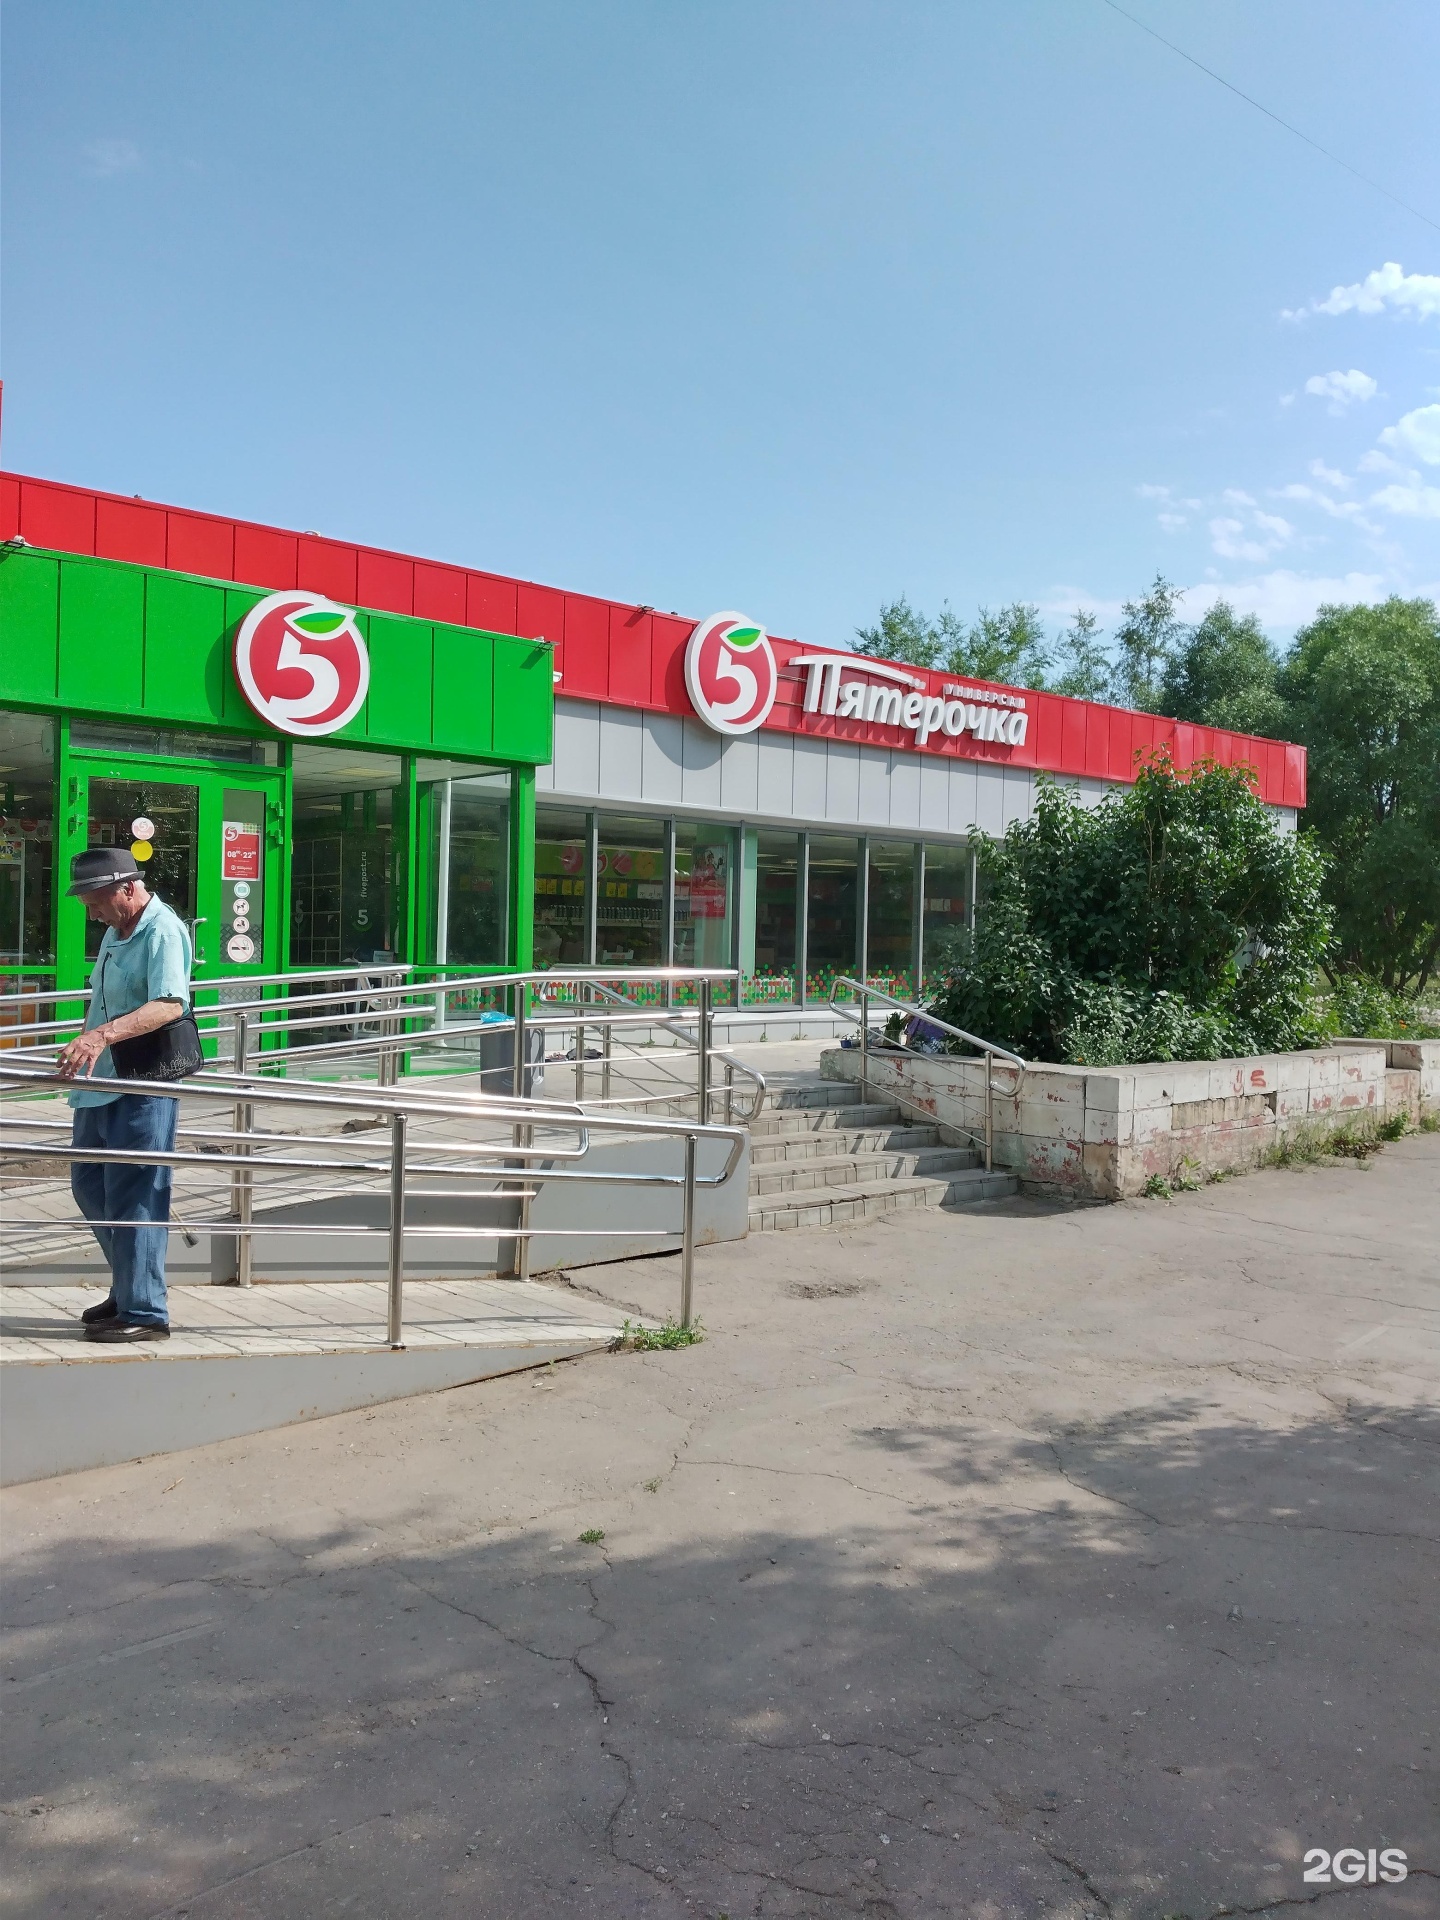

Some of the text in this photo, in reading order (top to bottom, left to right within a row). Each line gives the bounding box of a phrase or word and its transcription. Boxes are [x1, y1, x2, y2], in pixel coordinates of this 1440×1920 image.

[788, 654, 1029, 746] Пятёрочка
[943, 683, 1026, 709] УНИВЕРСАМ
[360, 851, 369, 899] fivepost.ru
[357, 909, 369, 926] 5
